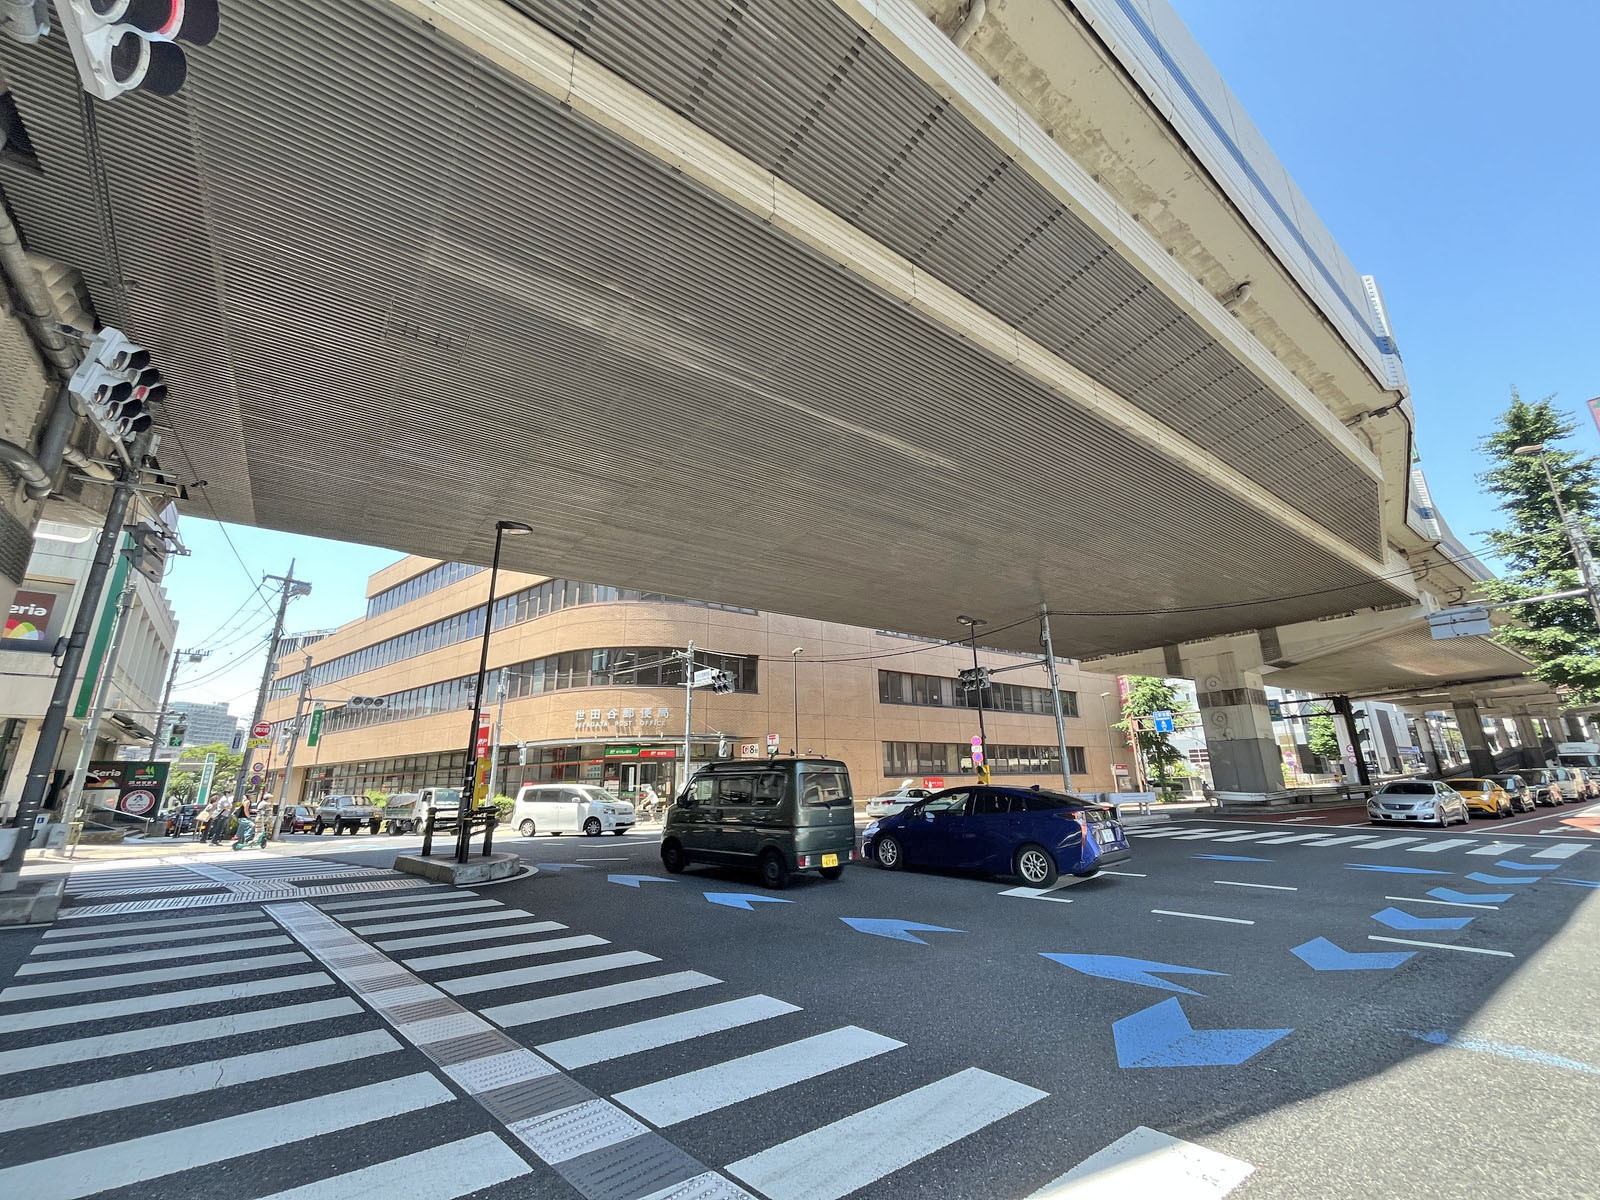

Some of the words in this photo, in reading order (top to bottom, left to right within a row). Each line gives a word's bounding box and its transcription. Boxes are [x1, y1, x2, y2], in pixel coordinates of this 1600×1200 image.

[9, 603, 48, 617] eria
[575, 707, 669, 720] 世田谷郵便局
[92, 768, 121, 777] Seria
